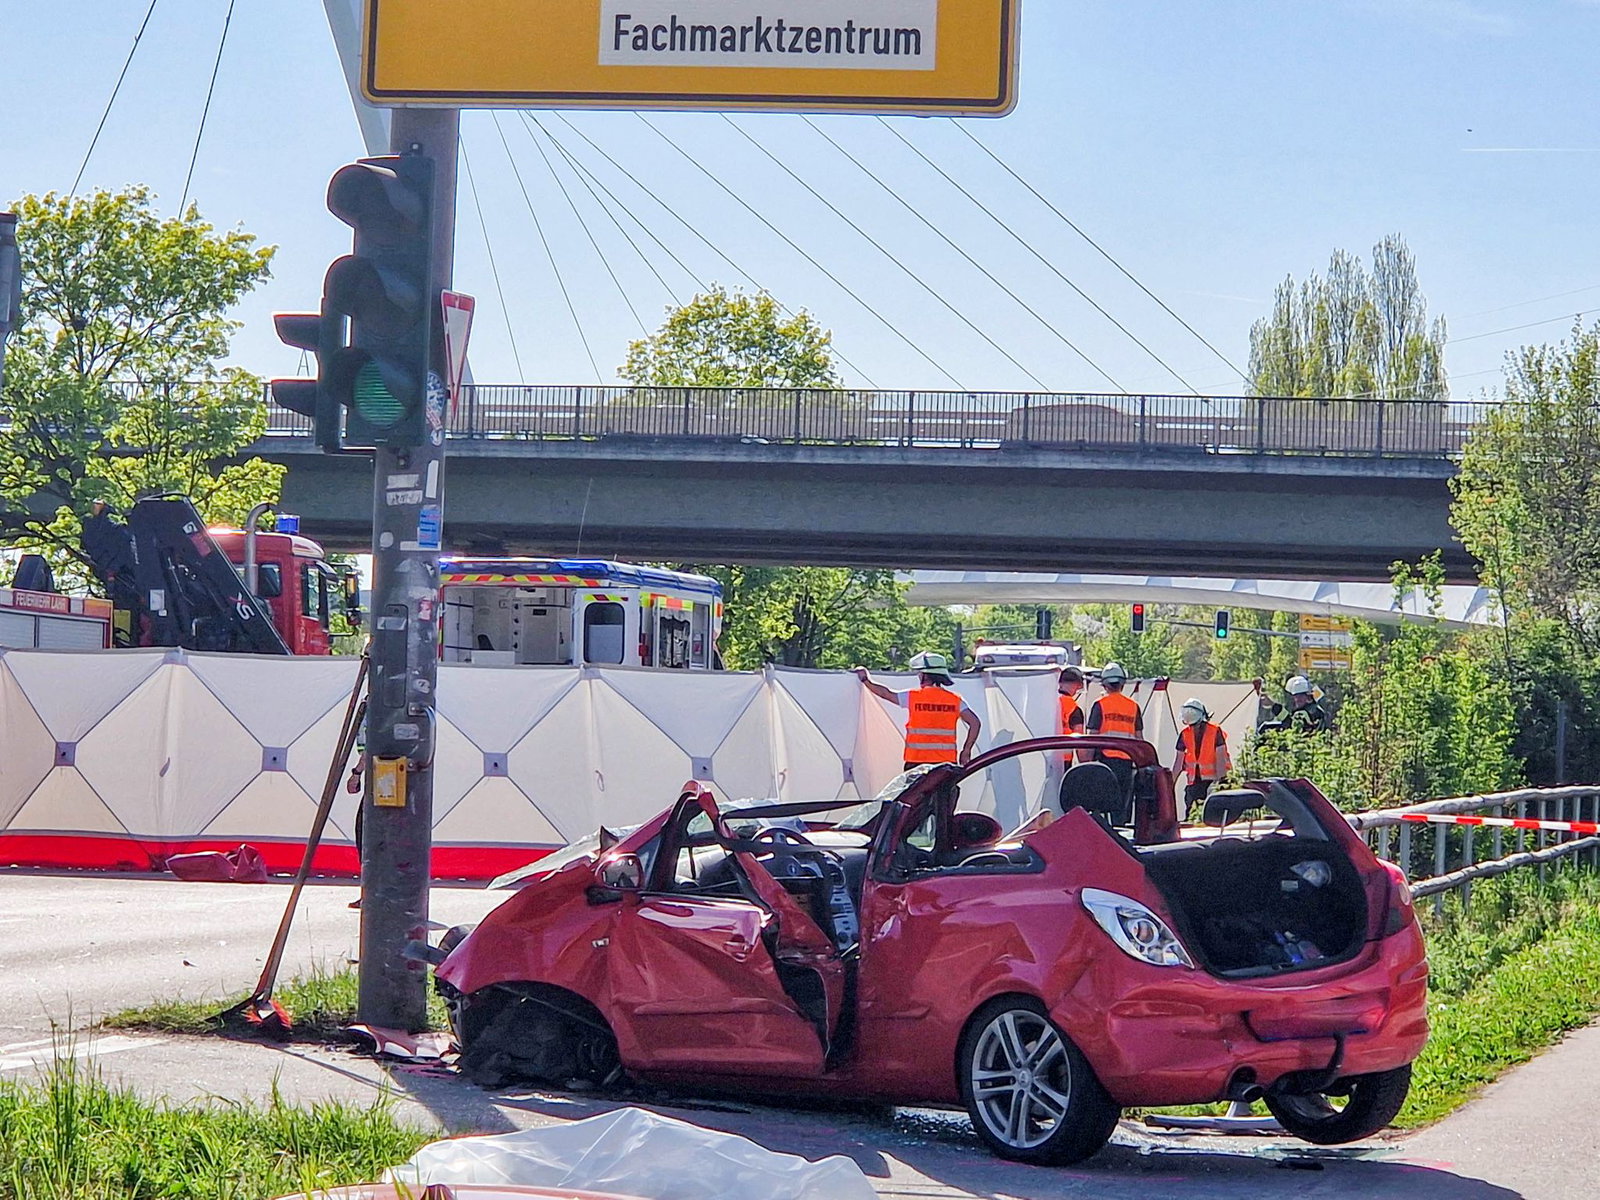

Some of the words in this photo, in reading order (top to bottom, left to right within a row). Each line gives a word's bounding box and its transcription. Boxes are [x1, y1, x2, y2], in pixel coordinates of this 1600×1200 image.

[613, 14, 922, 56] Fachmarktzentrum
[16, 592, 50, 608] FEUERWEHR
[914, 702, 956, 713] FEUERWEHR
